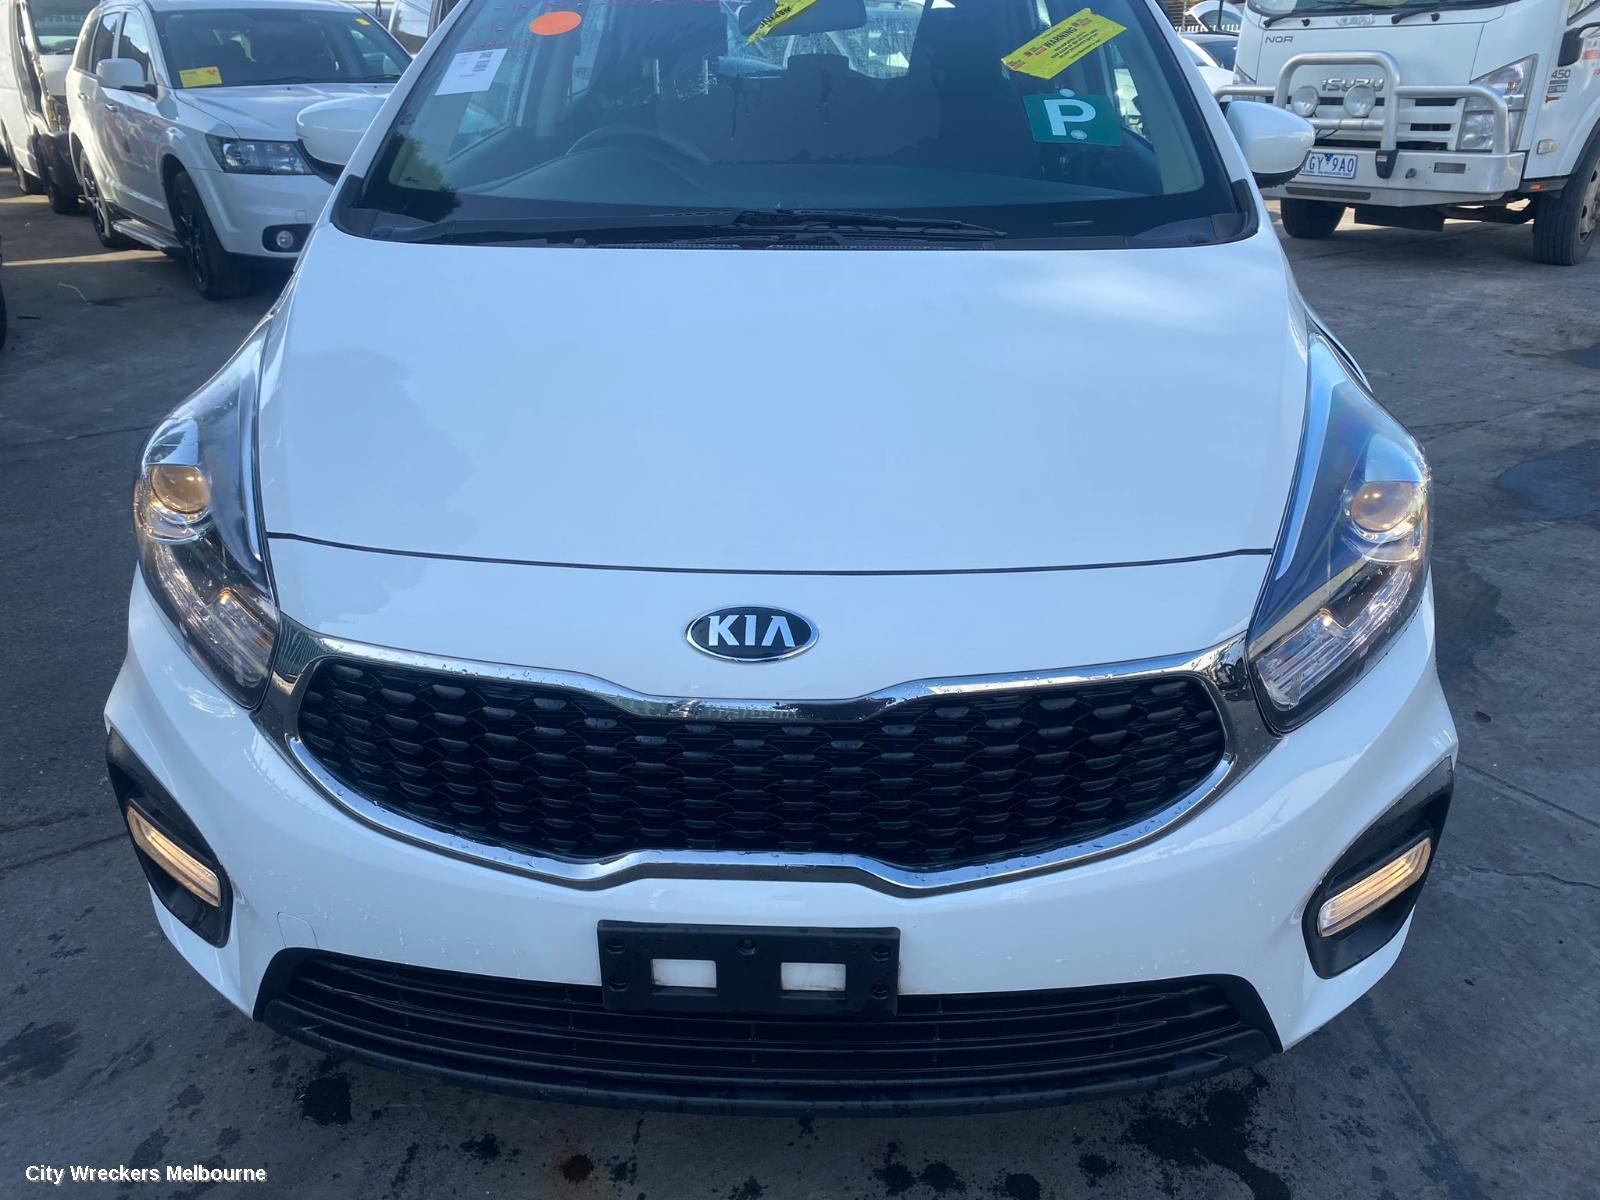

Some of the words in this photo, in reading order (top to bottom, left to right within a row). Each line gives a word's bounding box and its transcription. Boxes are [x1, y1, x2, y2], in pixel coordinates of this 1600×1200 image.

[1043, 26, 1078, 48] WARNING
[1551, 69, 1571, 79] 450
[1043, 98, 1097, 136] P
[708, 614, 796, 648] KIA
